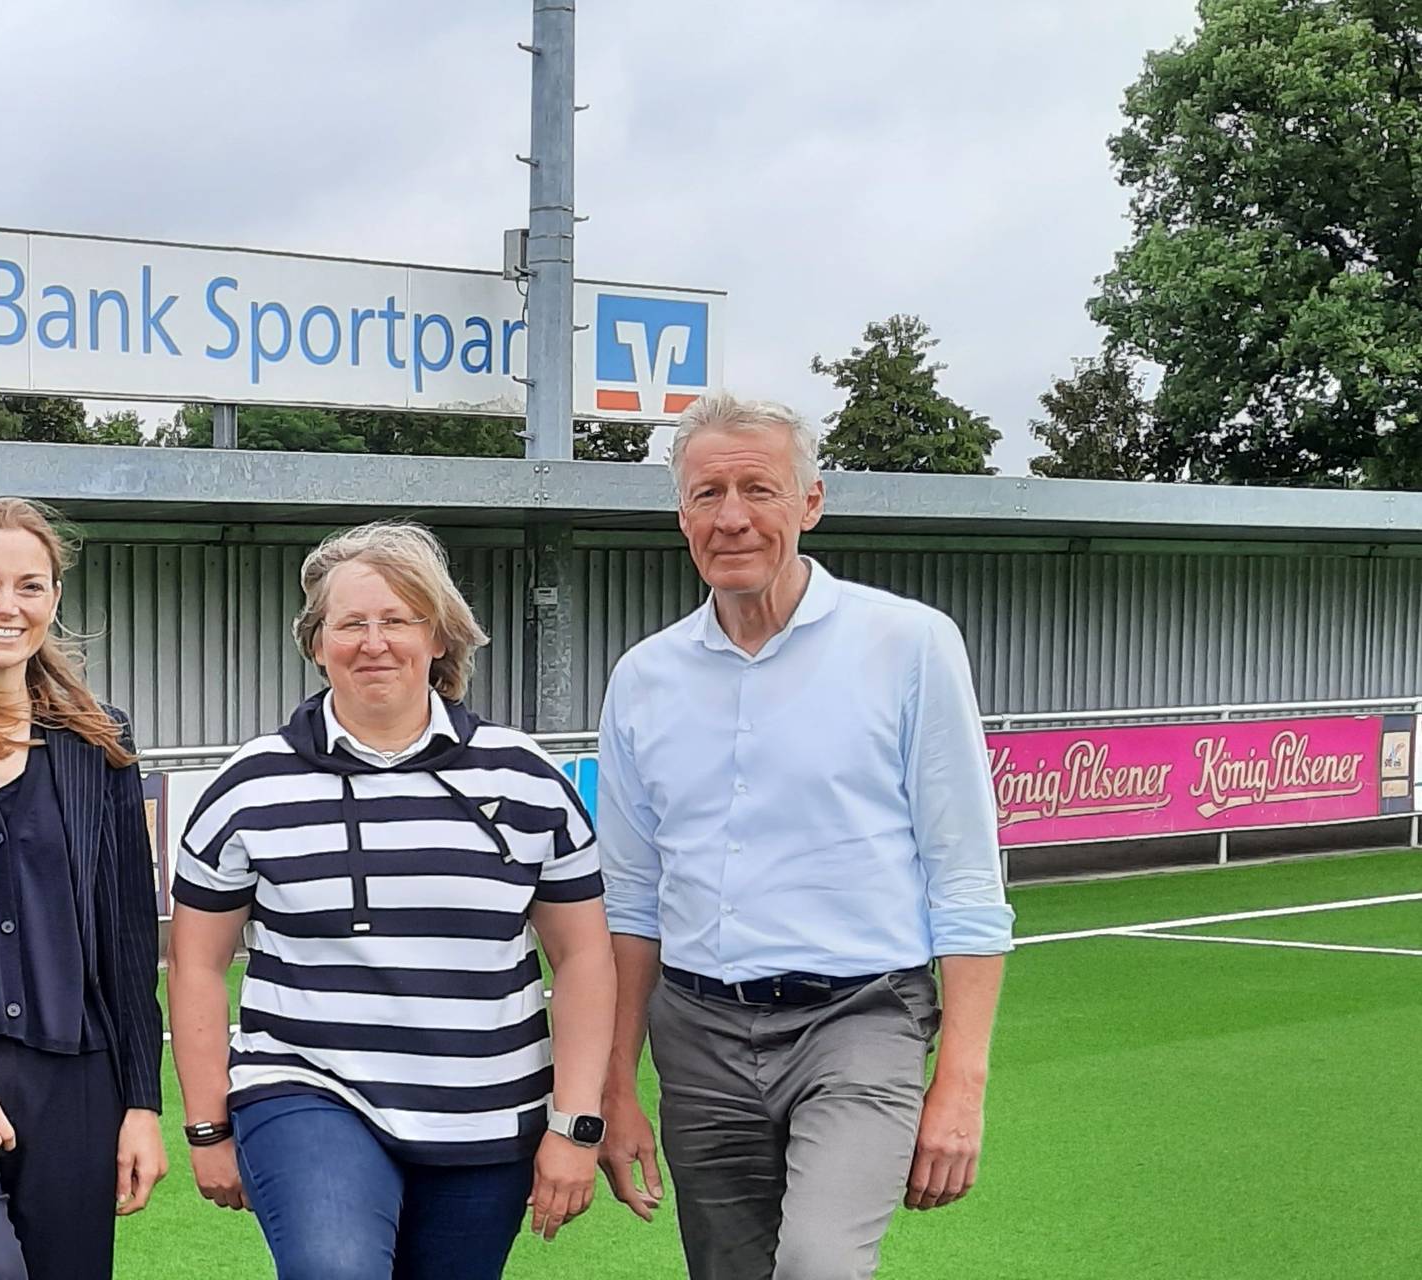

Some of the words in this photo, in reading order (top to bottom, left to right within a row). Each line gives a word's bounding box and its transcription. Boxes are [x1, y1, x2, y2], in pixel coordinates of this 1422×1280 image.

[204, 275, 526, 391] Sportpar
[1059, 739, 1173, 805] Pilsener
[1189, 736, 1272, 803] König
[1263, 729, 1363, 794] Pilsener
